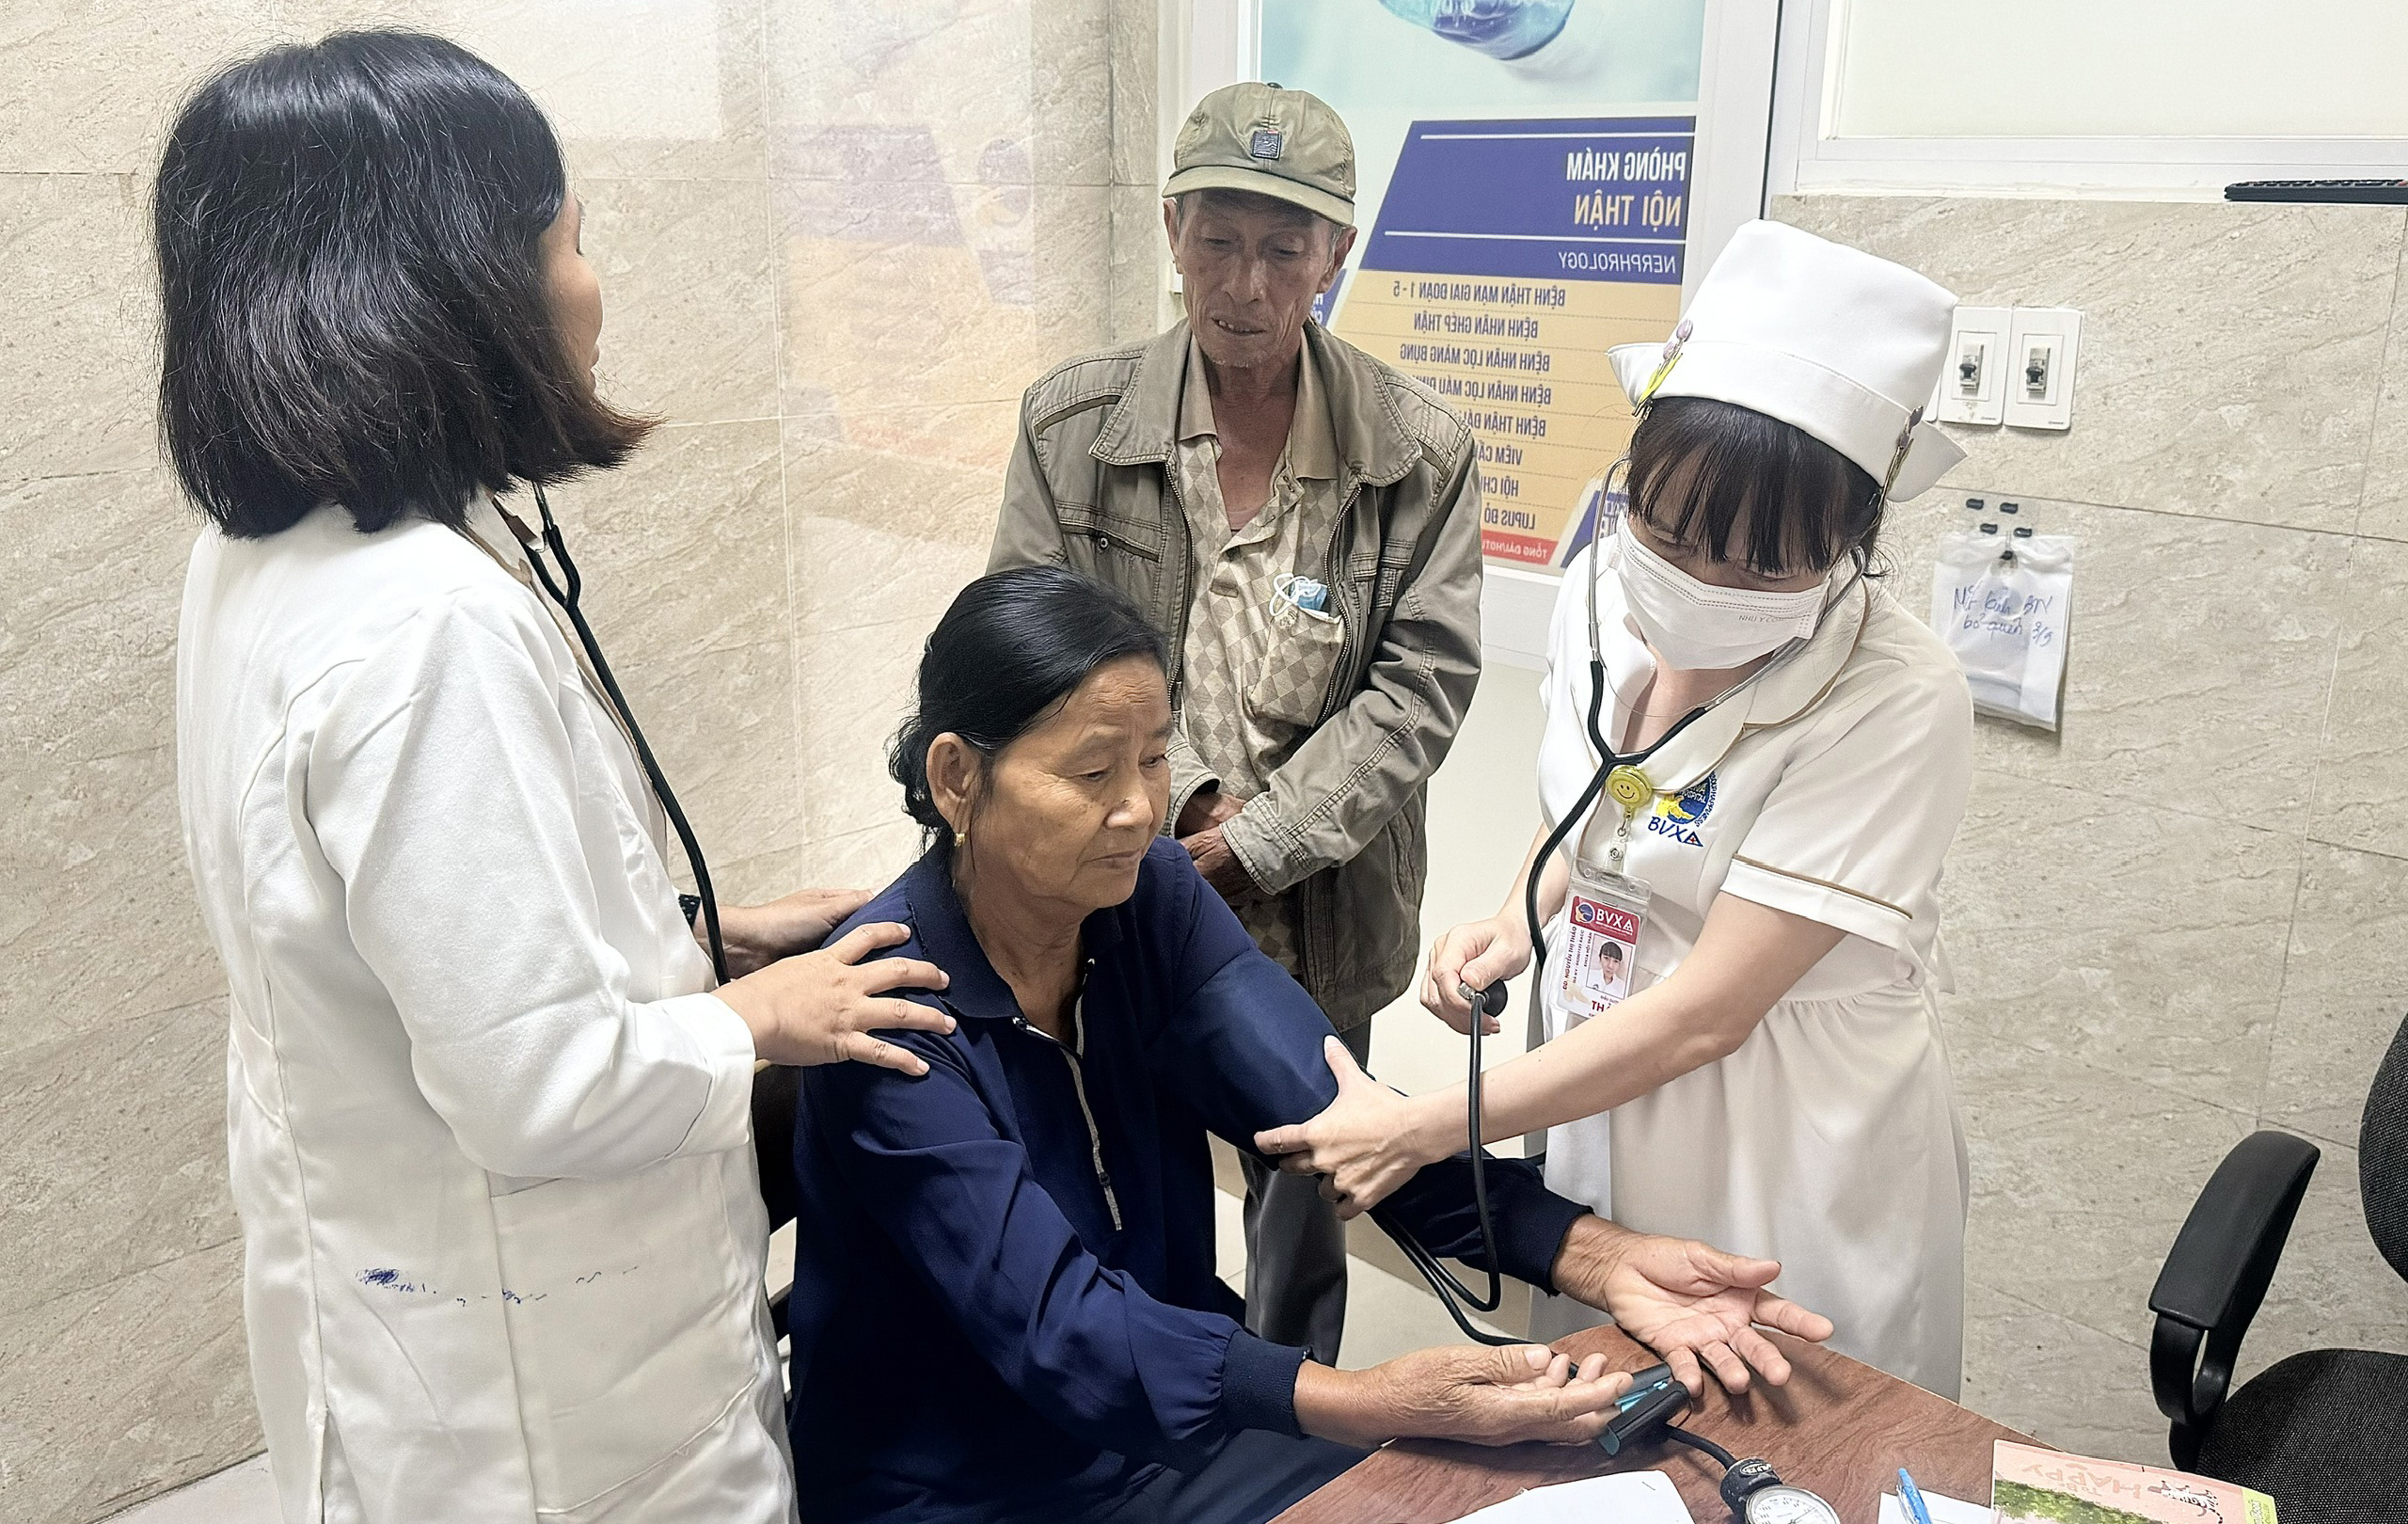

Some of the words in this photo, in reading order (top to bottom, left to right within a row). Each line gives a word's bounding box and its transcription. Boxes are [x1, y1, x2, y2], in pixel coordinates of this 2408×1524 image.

[1648, 816, 1703, 848] BVXA
[1596, 908, 1633, 932] BVXA
[2021, 1464, 2142, 1500] HAPPY
